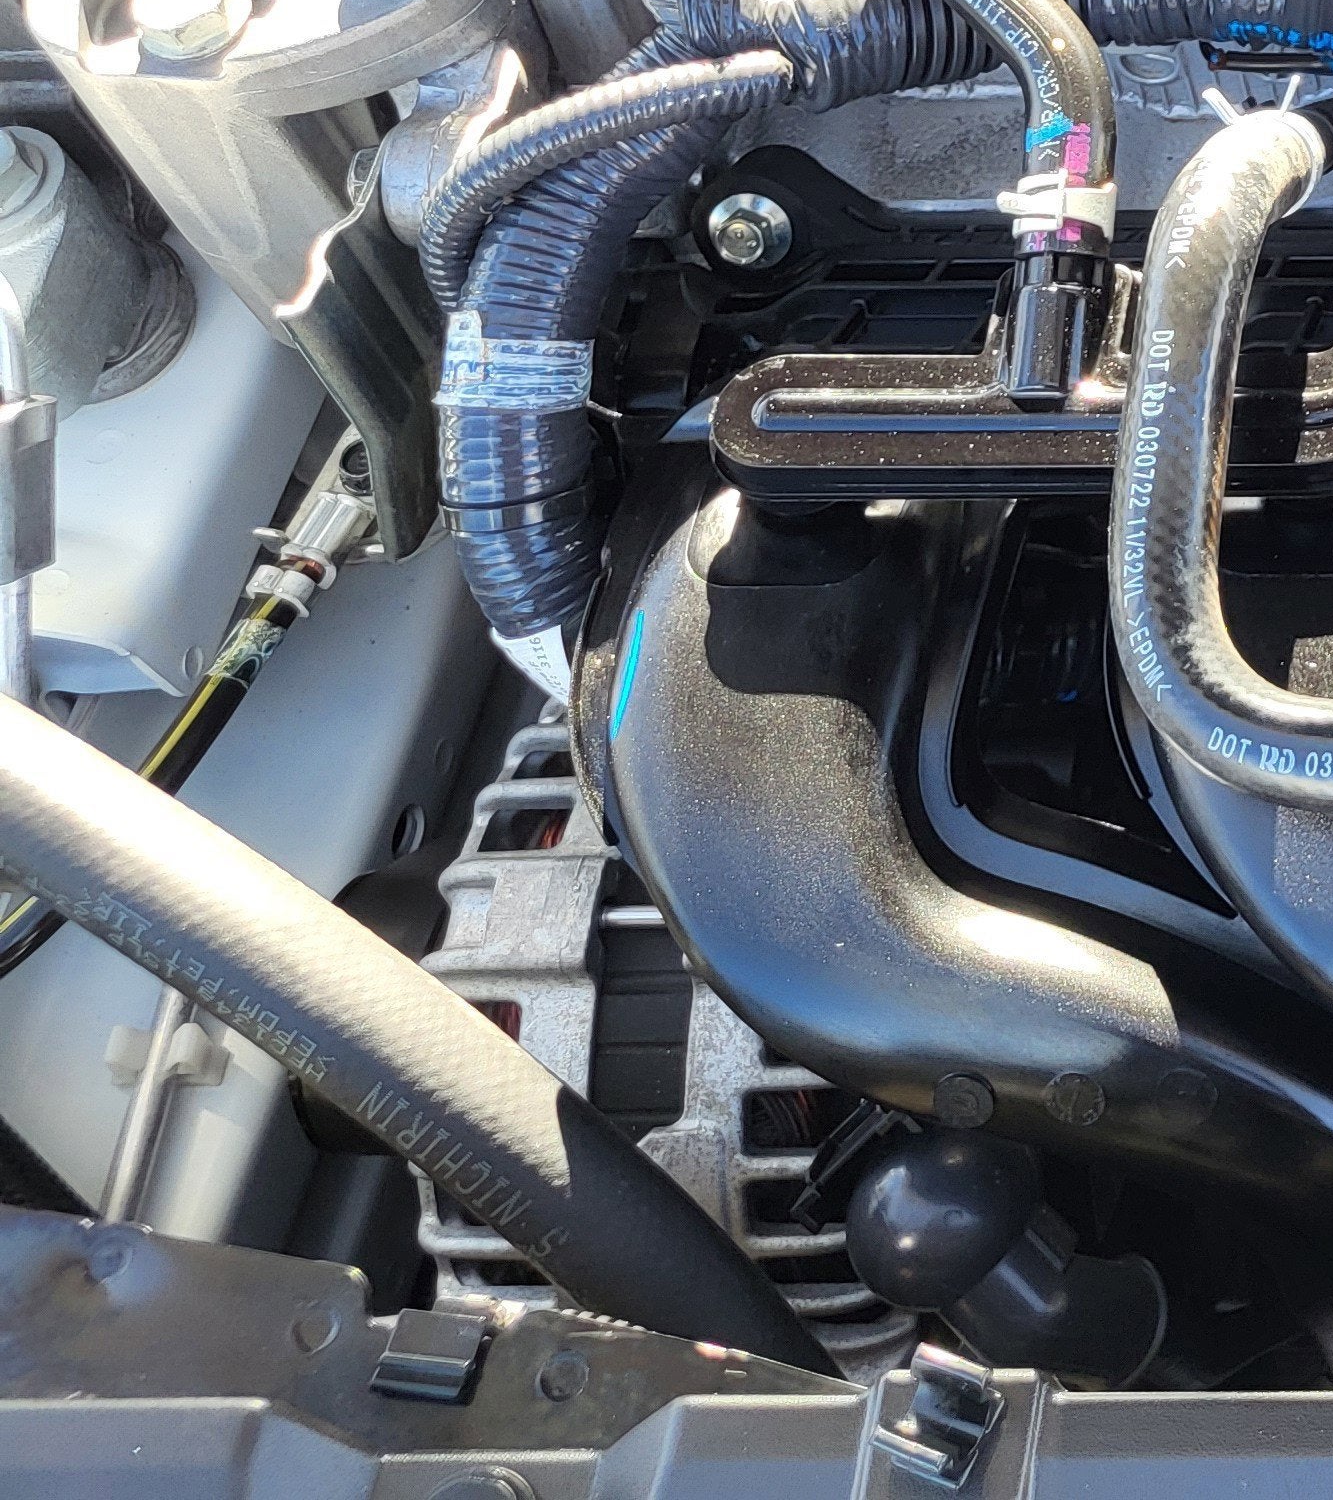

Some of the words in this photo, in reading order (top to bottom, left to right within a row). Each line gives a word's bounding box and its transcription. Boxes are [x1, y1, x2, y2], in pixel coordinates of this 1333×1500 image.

[1147, 329, 1176, 376] DOT
[1128, 425, 1161, 511] 030722
[1207, 726, 1248, 765] DOT
[356, 1080, 533, 1228] NICHIRIN
